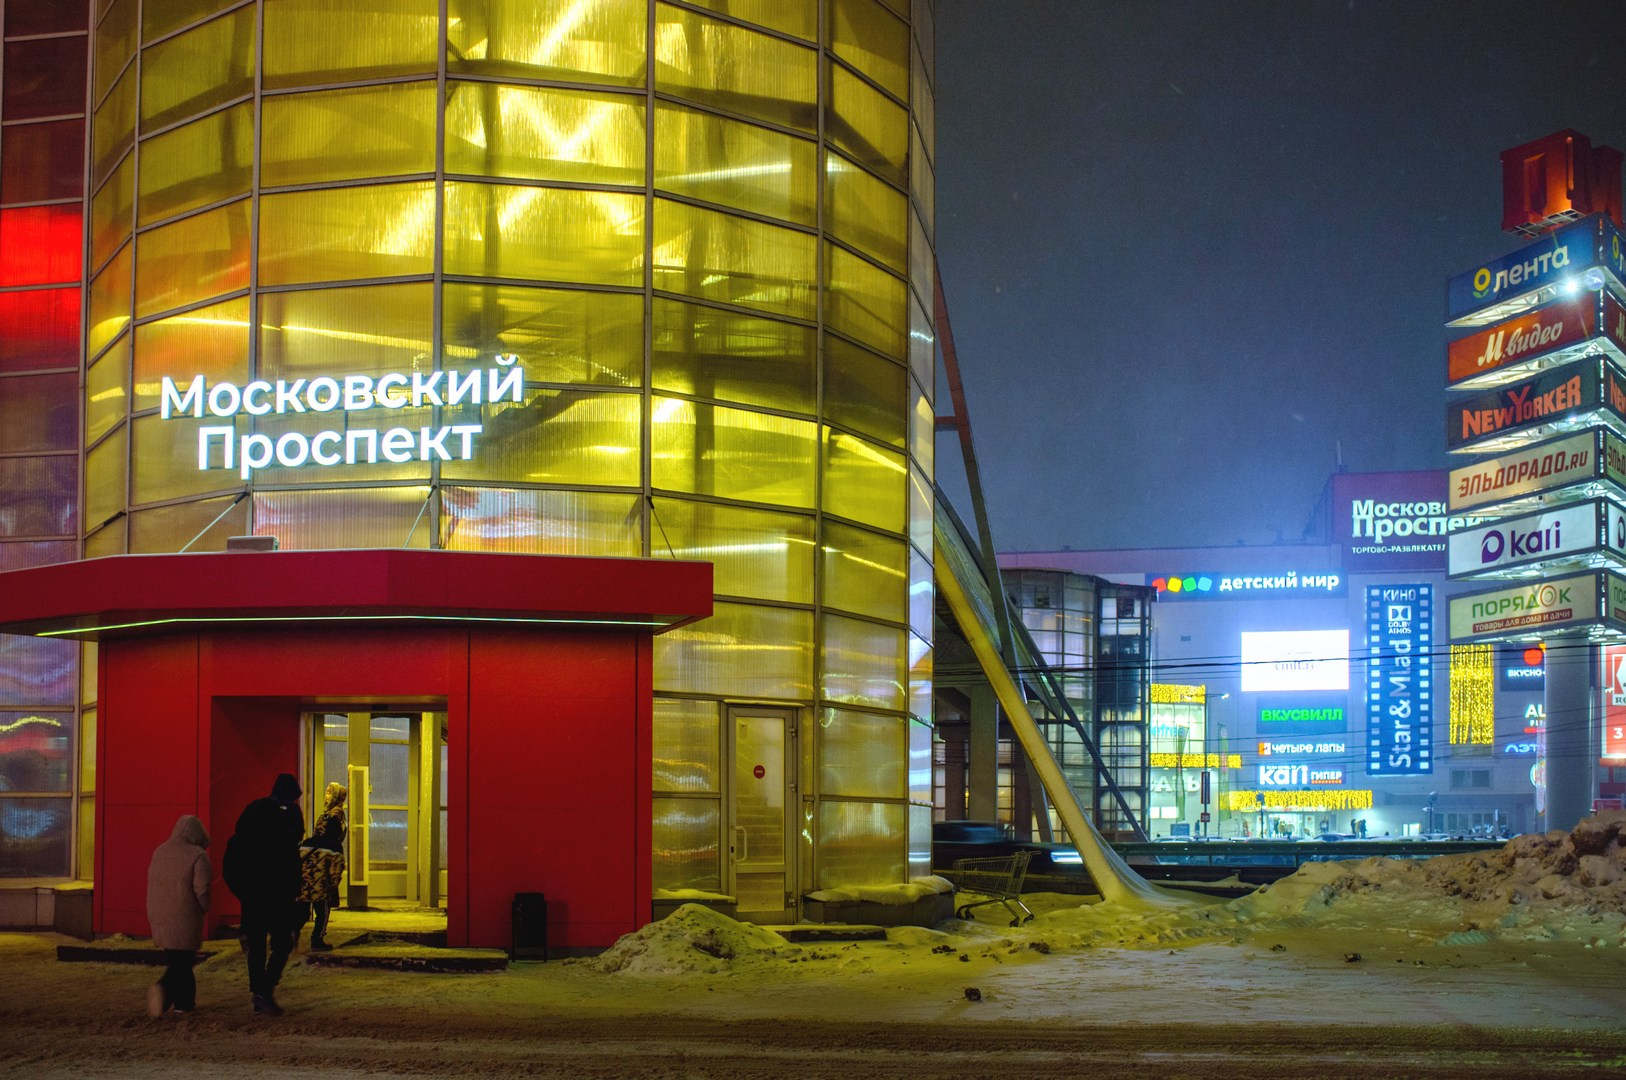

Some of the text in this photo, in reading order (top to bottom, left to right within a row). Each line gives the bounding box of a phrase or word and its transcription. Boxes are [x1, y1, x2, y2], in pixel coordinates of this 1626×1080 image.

[160, 354, 523, 420] Московский
[198, 424, 483, 480] Проспект
[1352, 499, 1446, 518] Москов
[1511, 521, 1560, 557] kari
[1219, 571, 1339, 591] детский мир
[1383, 589, 1416, 601] КИНО
[1472, 585, 1572, 618] ПОРЯДОК
[1475, 621, 1504, 632] товары
[1505, 619, 1520, 627] для
[1521, 616, 1541, 625] дома
[1261, 708, 1343, 721] ВКУСВИЛЛ
[1259, 765, 1308, 785] kari
